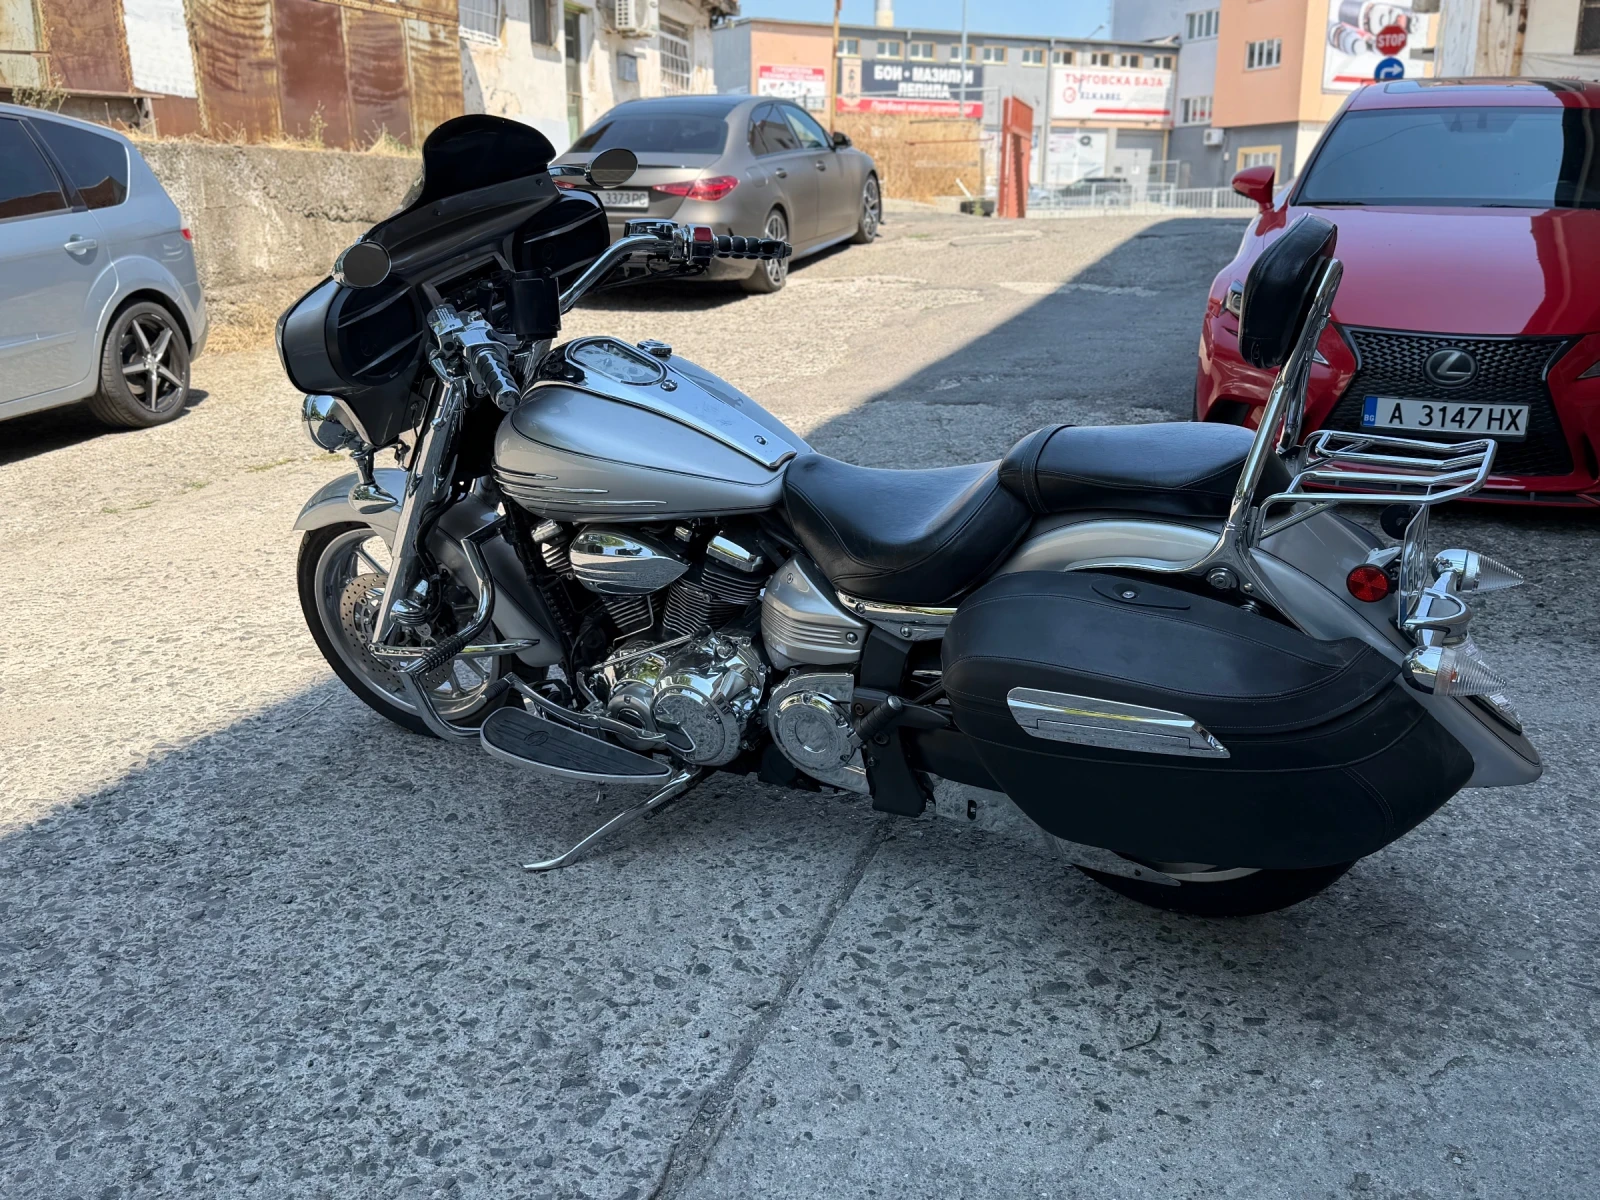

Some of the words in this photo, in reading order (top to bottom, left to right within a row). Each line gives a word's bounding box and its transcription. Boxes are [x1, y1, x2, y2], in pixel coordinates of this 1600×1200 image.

[1378, 34, 1405, 47] STOP
[873, 65, 903, 80] БОИ
[1064, 73, 1131, 86] ТЪРГОВСКА
[1134, 77, 1164, 87] БАЗА
[605, 193, 630, 204] 3373
[632, 193, 646, 205] PC
[1363, 414, 1375, 422] BG
[1389, 403, 1403, 424] A
[1418, 404, 1483, 429] 3147
[1486, 408, 1523, 432] HX
